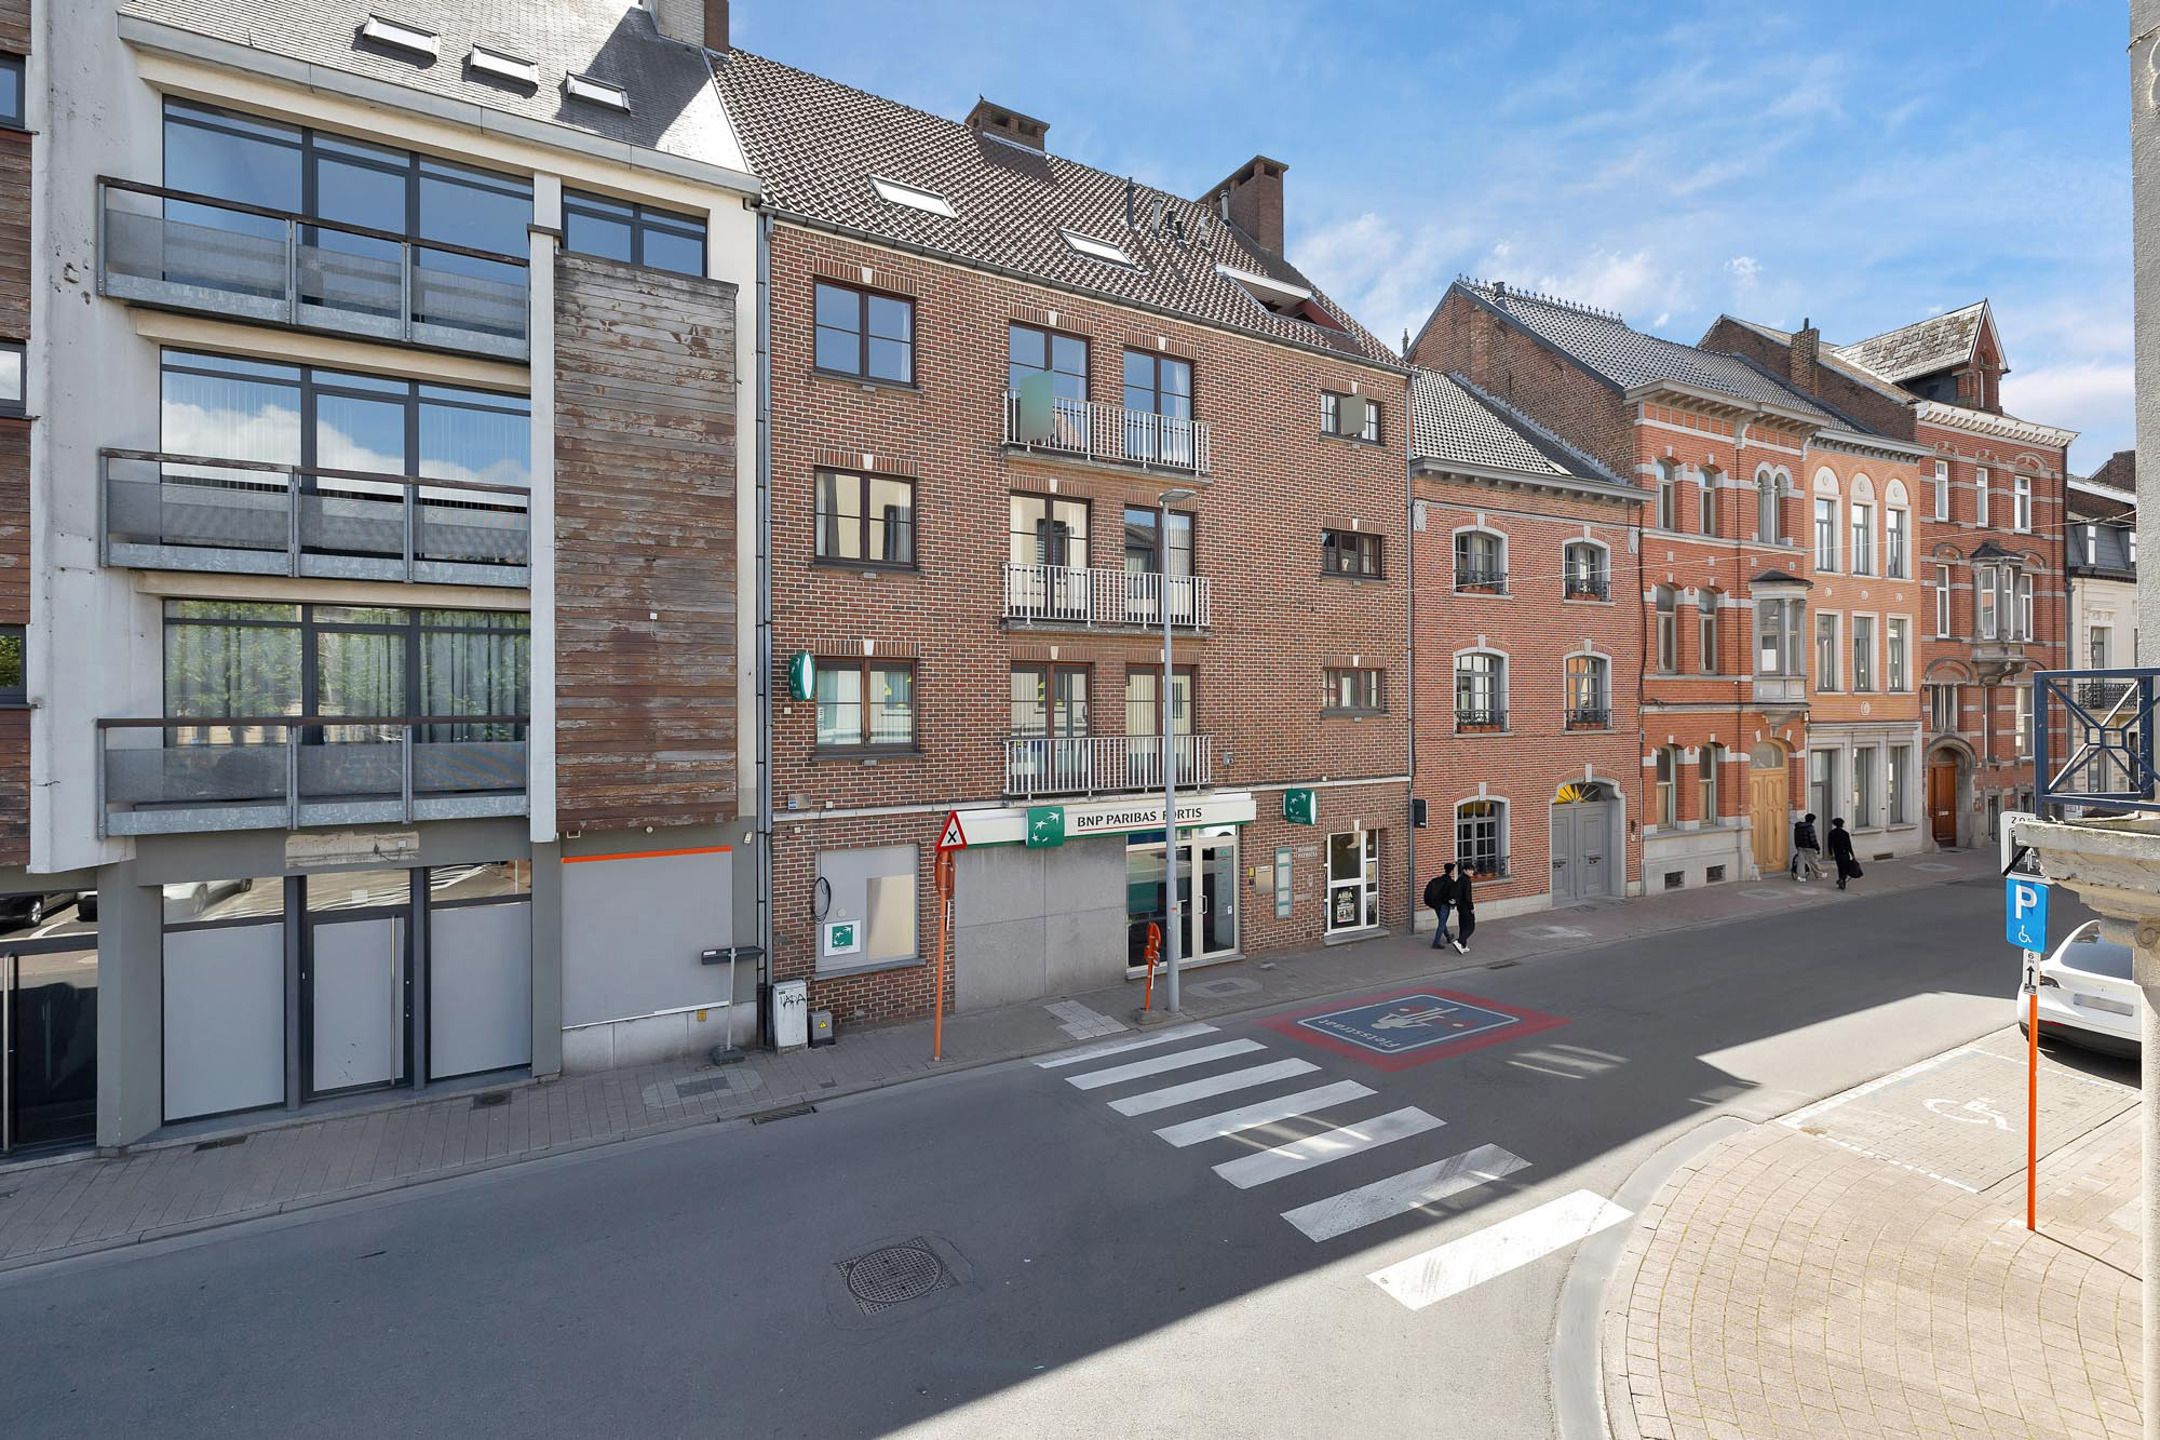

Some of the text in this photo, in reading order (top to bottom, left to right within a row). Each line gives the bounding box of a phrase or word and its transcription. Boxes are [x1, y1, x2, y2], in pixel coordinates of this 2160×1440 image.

[1077, 807, 1202, 827] BNP PARIBAS FRTIS
[2015, 884, 2037, 919] P
[2027, 952, 2035, 960] 6
[1317, 1019, 1401, 1048] Fietsstraat
